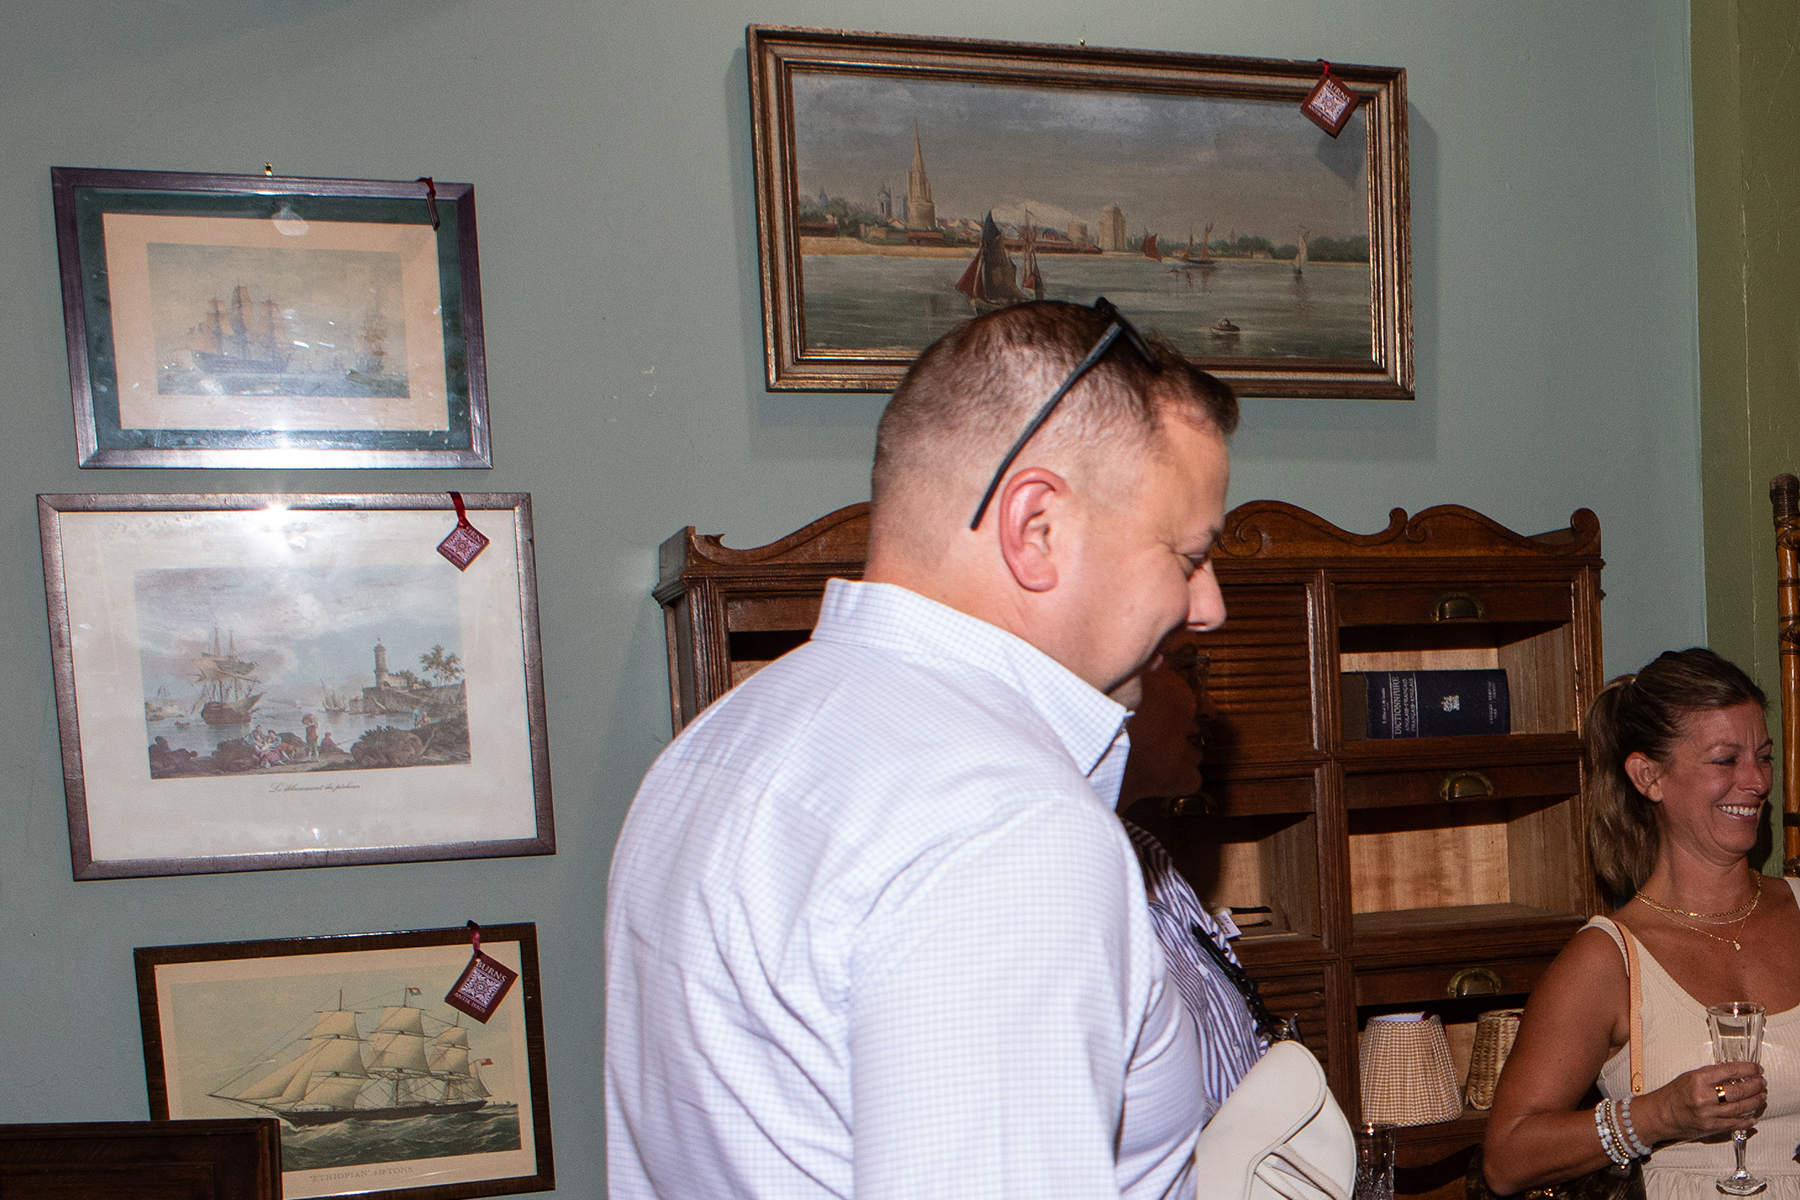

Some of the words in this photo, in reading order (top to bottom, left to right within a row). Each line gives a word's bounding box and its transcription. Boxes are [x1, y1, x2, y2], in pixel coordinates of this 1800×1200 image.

[1326, 80, 1352, 104] BURNS
[1391, 676, 1402, 735] DICTIONNAIRE
[475, 960, 508, 983] BURNS
[454, 992, 471, 1005] ANTIK
